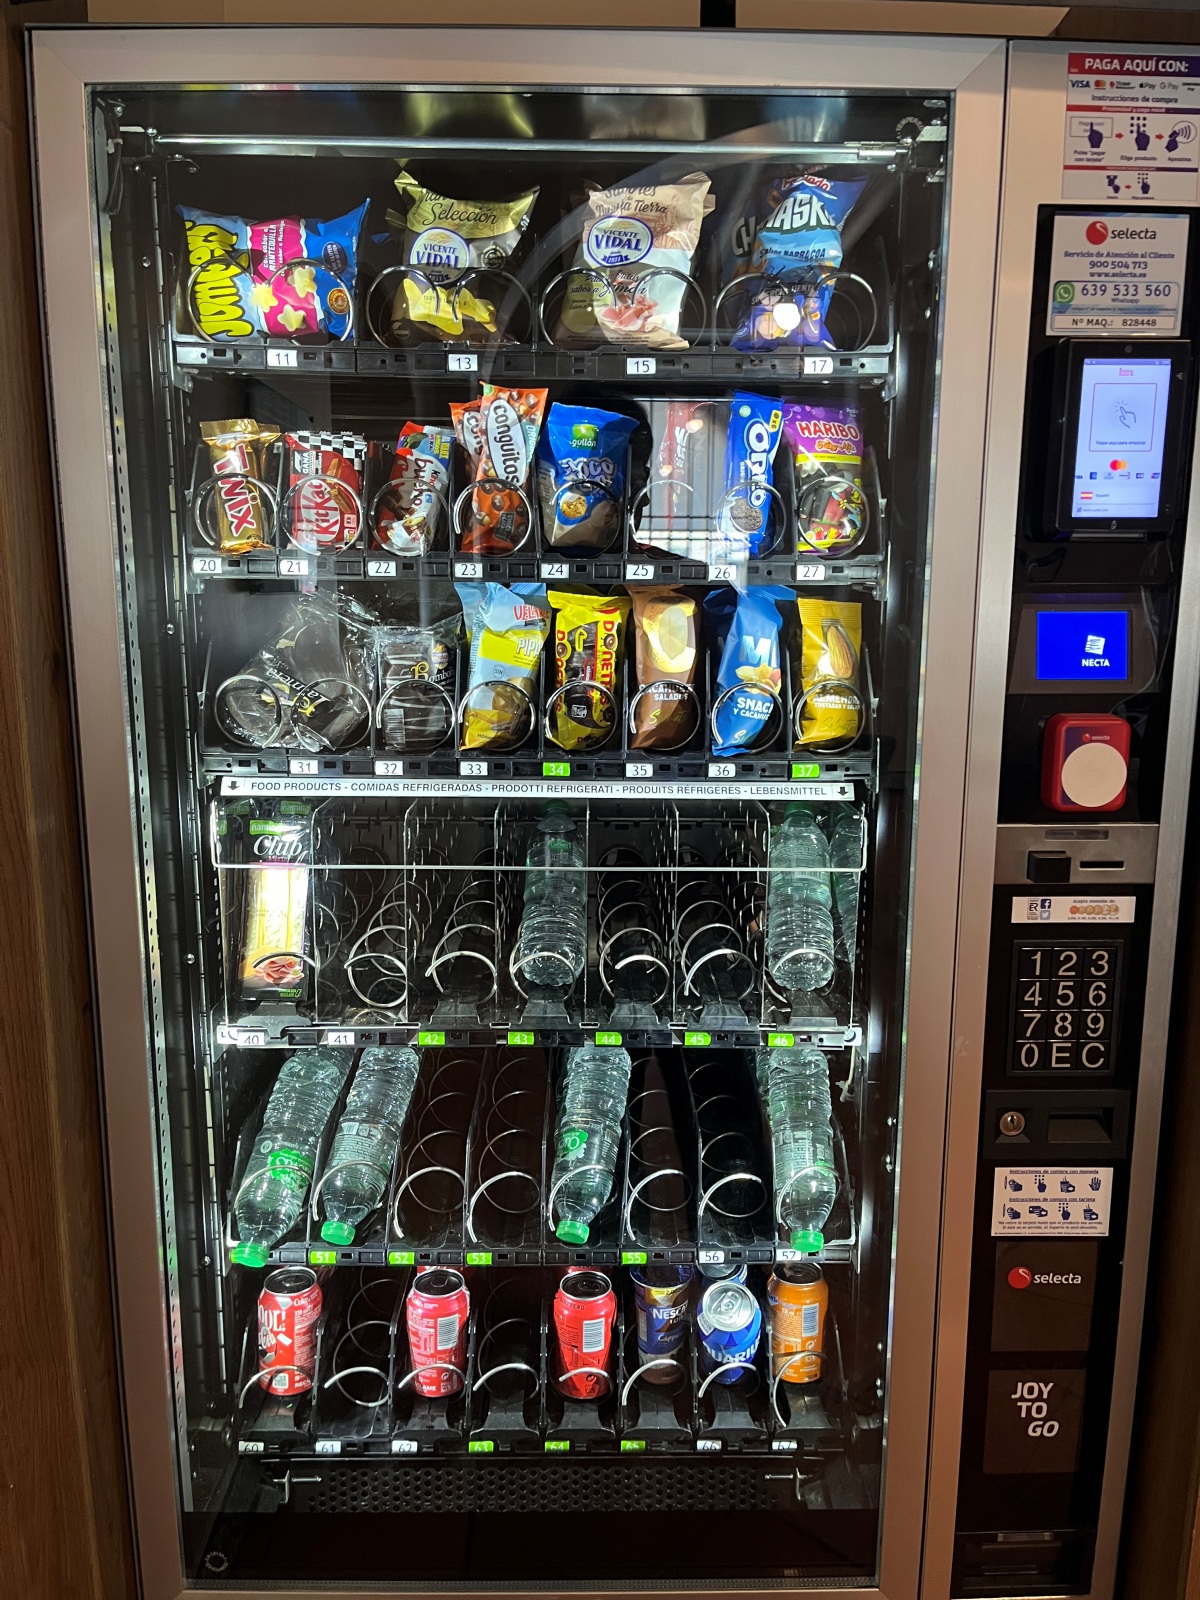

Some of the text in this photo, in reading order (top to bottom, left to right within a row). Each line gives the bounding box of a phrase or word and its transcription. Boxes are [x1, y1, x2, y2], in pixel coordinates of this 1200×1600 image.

[1085, 58, 1189, 72] PAGA AQUÍ CON:
[1070, 80, 1090, 88] VISA
[1168, 82, 1178, 90] Pay
[634, 200, 668, 214] Tierra
[422, 202, 498, 226] Selección
[603, 228, 639, 238] VICENTE
[1110, 228, 1156, 240] selecta
[268, 224, 277, 272] MANTEQUILLA
[594, 234, 642, 251] VIDAL
[424, 244, 458, 255] VICENTE
[784, 248, 826, 260] BARBACOA
[416, 251, 461, 270] VIDAL
[1089, 260, 1148, 269] 900 504 713
[571, 285, 590, 293] sabor
[1081, 284, 1171, 297] 639 533 560
[1122, 318, 1157, 327] 828448
[276, 353, 290, 366] 11
[456, 356, 471, 370] 13
[634, 360, 650, 373] 15
[812, 360, 826, 372] 17
[796, 420, 860, 441] HARIBO
[572, 438, 596, 447] gullón
[302, 452, 312, 474] GANA
[747, 422, 772, 506] OREO
[412, 458, 434, 505] bueno
[214, 444, 256, 536] TWIX
[303, 480, 340, 539] KitKat
[200, 560, 216, 572] 20
[286, 560, 301, 572] 21
[374, 562, 390, 574] 22
[461, 563, 477, 576] 23
[547, 564, 564, 576] 24
[632, 564, 648, 576] 25
[803, 566, 818, 578] 27
[714, 567, 730, 578] 26
[1082, 659, 1110, 667] NECTA
[298, 762, 312, 773] 31
[382, 763, 398, 774] 32
[467, 764, 482, 774] 33
[550, 765, 564, 774] 34
[632, 765, 648, 776] 35
[714, 766, 730, 776] 36
[798, 766, 813, 776] 37
[251, 782, 827, 796] FOOD PRODUCTS COMIDAS REFRIGERADAS PRODOTTI REFRIGERATI PRODUITS RÉFRIGÉRÉS LEBENSMITTEL
[254, 834, 302, 856] Club
[1031, 951, 1041, 976] 1
[1058, 951, 1077, 976] 2
[1090, 951, 1109, 976] 3
[1024, 982, 1042, 1006] 4
[1056, 982, 1074, 1006] 5
[1088, 982, 1106, 1006] 6
[1023, 1013, 1041, 1037] 7
[1054, 1012, 1072, 1037] 8
[1086, 1012, 1105, 1037] 9
[245, 1034, 260, 1044] 40
[334, 1033, 348, 1044] 41
[424, 1034, 439, 1044] 42
[514, 1034, 528, 1044] 43
[601, 1035, 616, 1044] 44
[690, 1034, 704, 1044] 45
[773, 1036, 788, 1046] 46
[1020, 1043, 1039, 1068] 0
[1052, 1043, 1072, 1068] E
[1081, 1042, 1105, 1068] C
[316, 1252, 330, 1262] 51
[394, 1253, 408, 1264] 52
[472, 1253, 486, 1263] 53
[627, 1253, 642, 1263] 55
[705, 1252, 719, 1262] 56
[782, 1250, 796, 1260] 57
[1033, 1273, 1082, 1284] selecta
[1011, 1382, 1054, 1399] JOY
[1017, 1402, 1048, 1418] TO
[1027, 1421, 1060, 1437] GO
[244, 1442, 258, 1452] 60
[322, 1443, 334, 1453] 61
[398, 1443, 412, 1453] 62
[474, 1442, 488, 1452] 63
[550, 1442, 564, 1452] 64
[626, 1442, 640, 1452] 65
[702, 1441, 717, 1450] 66
[778, 1441, 791, 1450] 67
